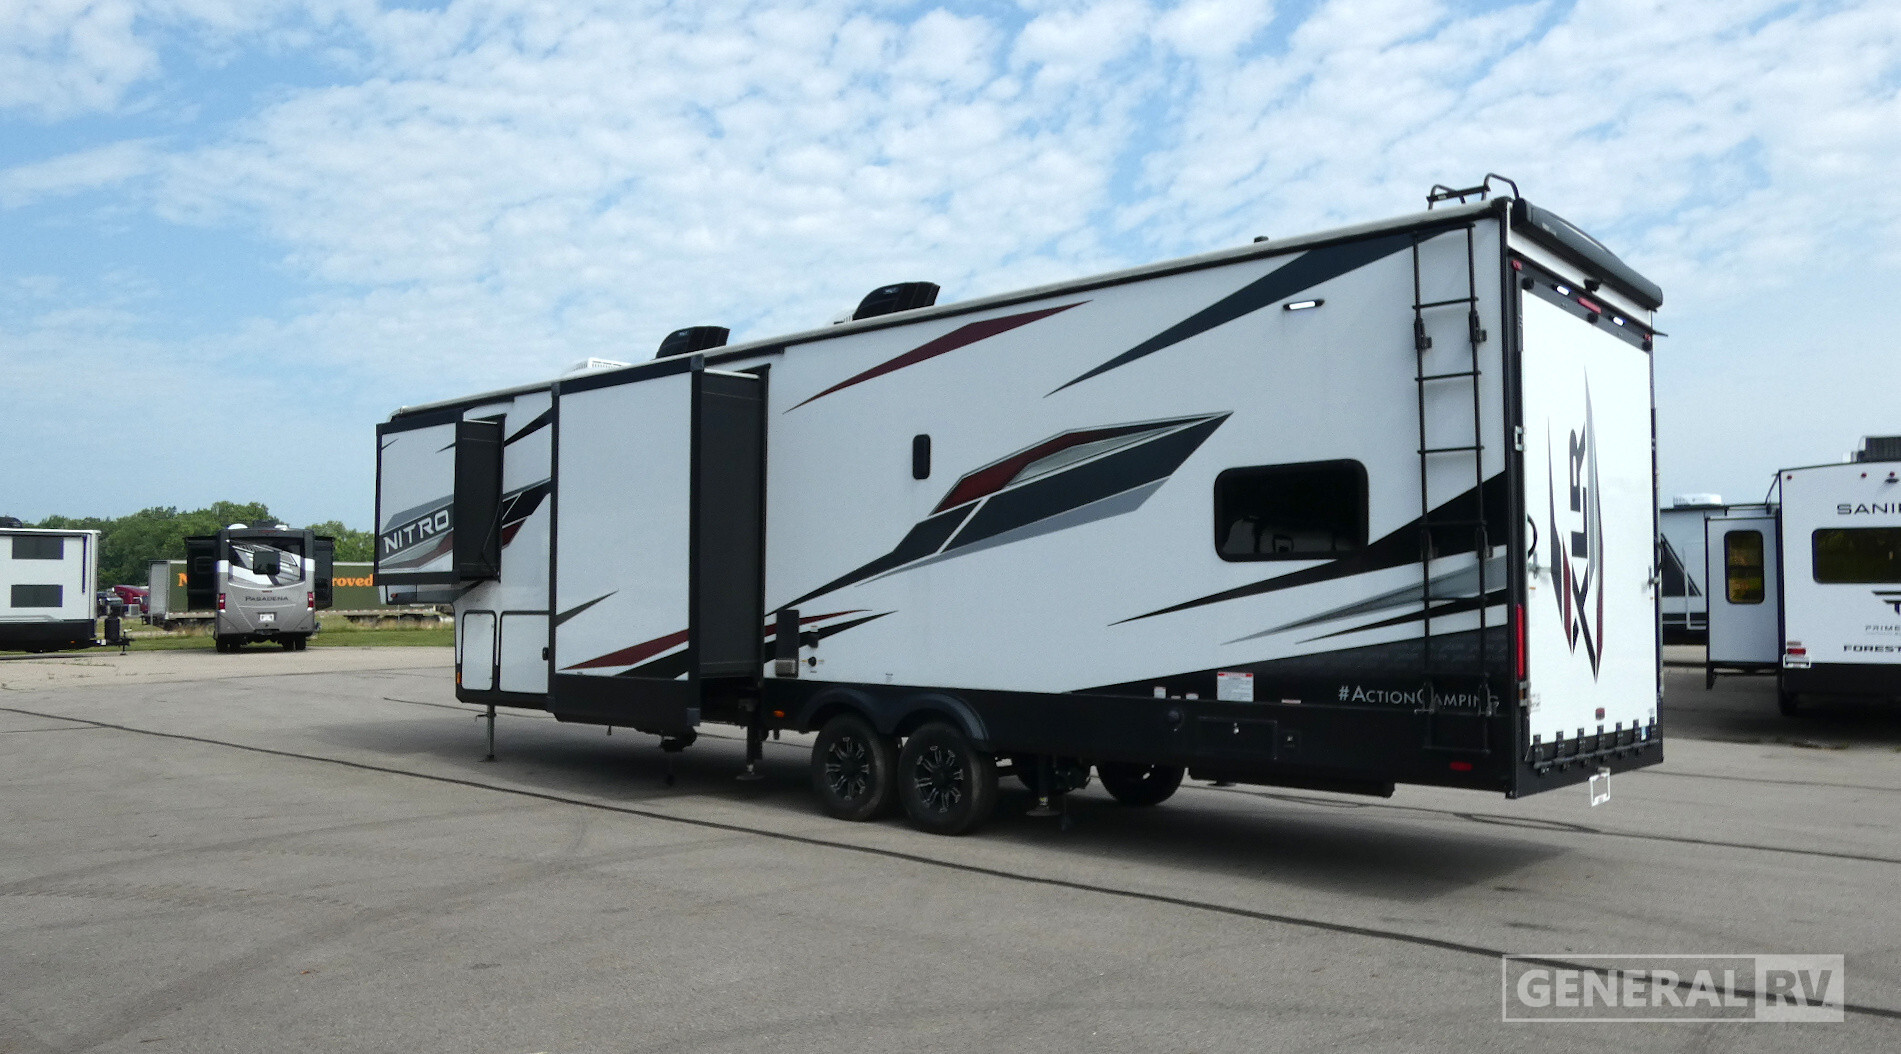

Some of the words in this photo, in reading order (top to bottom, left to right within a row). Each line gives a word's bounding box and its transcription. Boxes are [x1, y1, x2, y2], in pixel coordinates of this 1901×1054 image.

[1837, 503, 1901, 514] SANI
[383, 509, 449, 554] NITRO
[1569, 421, 1598, 684] XLR
